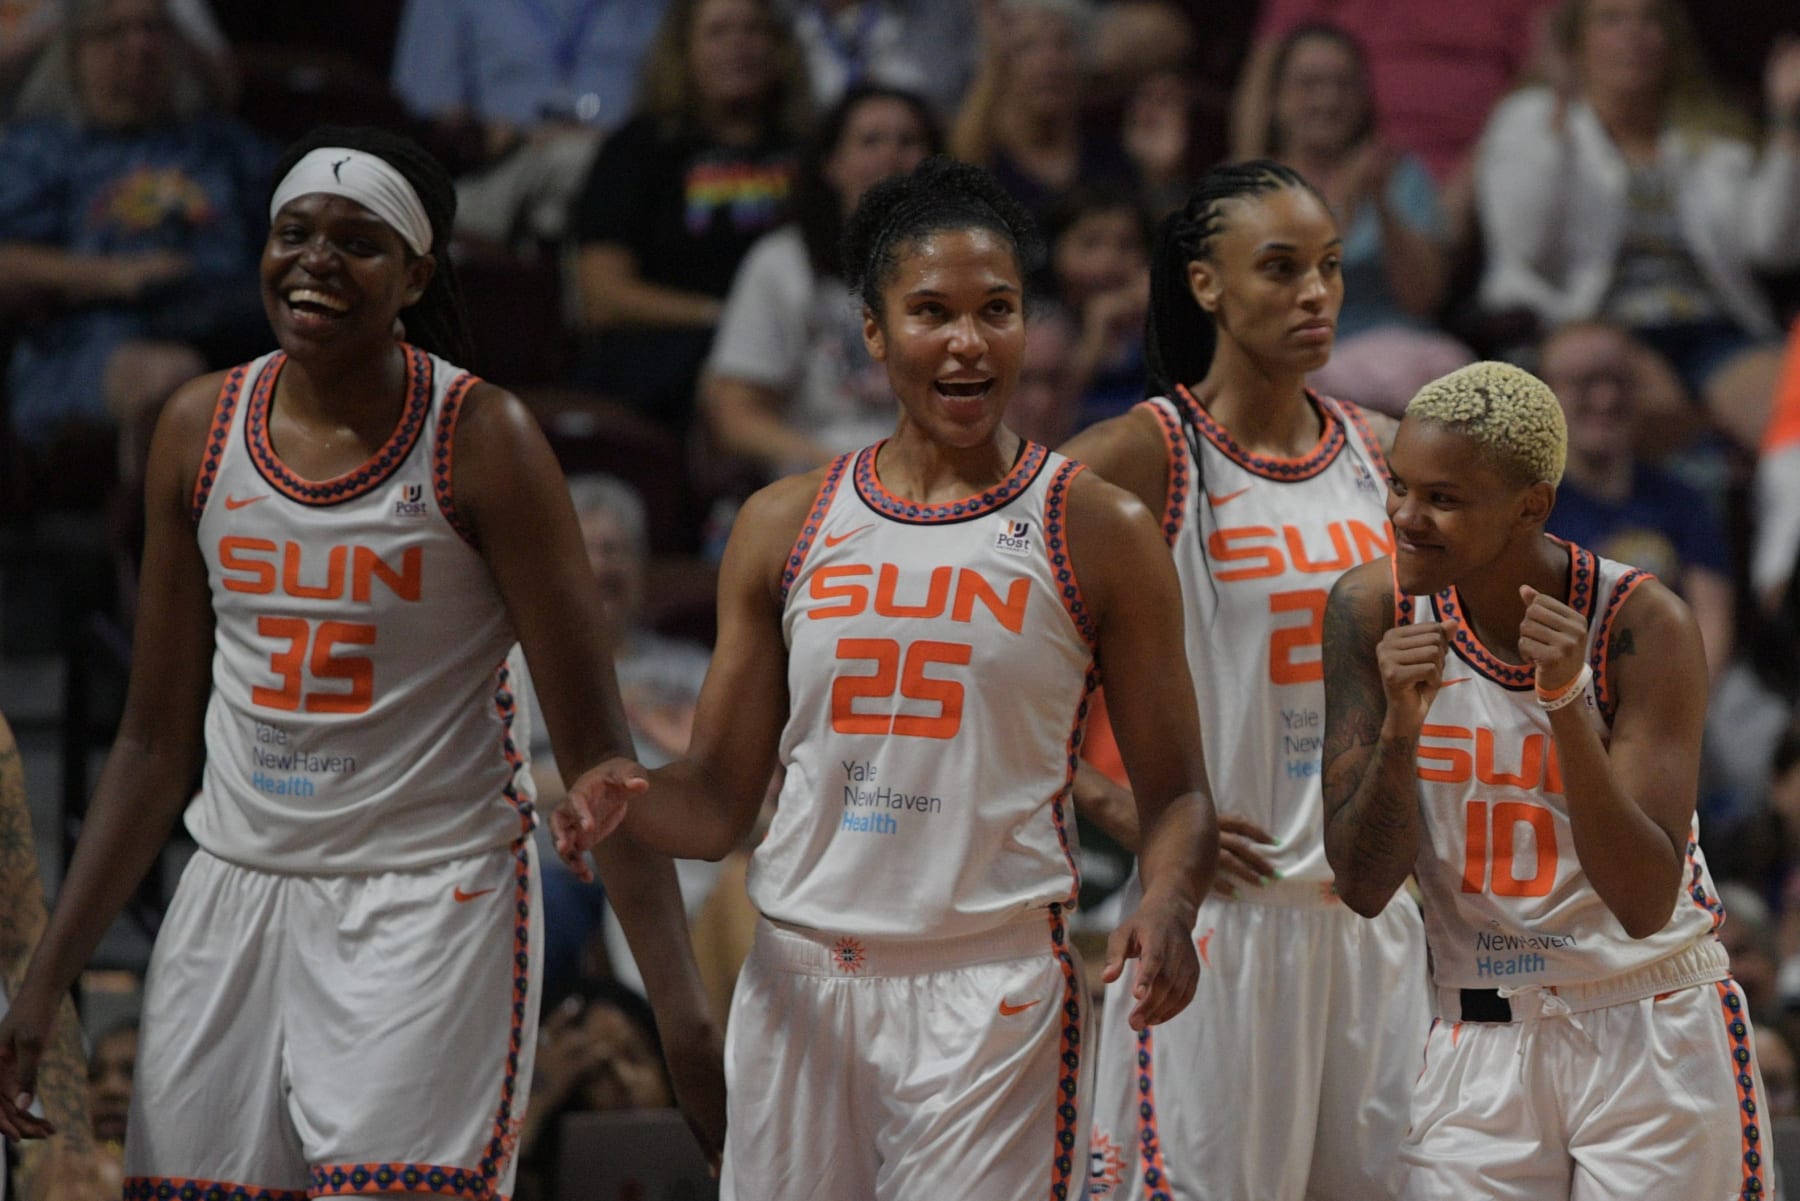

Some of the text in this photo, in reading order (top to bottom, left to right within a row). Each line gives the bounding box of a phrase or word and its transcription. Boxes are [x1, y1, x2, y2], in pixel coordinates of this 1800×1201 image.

[998, 533, 1031, 550] Post
[219, 536, 422, 603] SUN
[807, 563, 1031, 634] SUN
[252, 616, 376, 713] 35
[831, 638, 972, 739] 25
[1281, 709, 1319, 729] Yale
[253, 746, 356, 773] NewHaven
[842, 760, 877, 782] Yale
[253, 770, 315, 797] Health
[844, 785, 941, 813] NewHaven
[841, 811, 897, 835] Health
[1461, 801, 1558, 897] 10
[1476, 953, 1545, 976] Health
